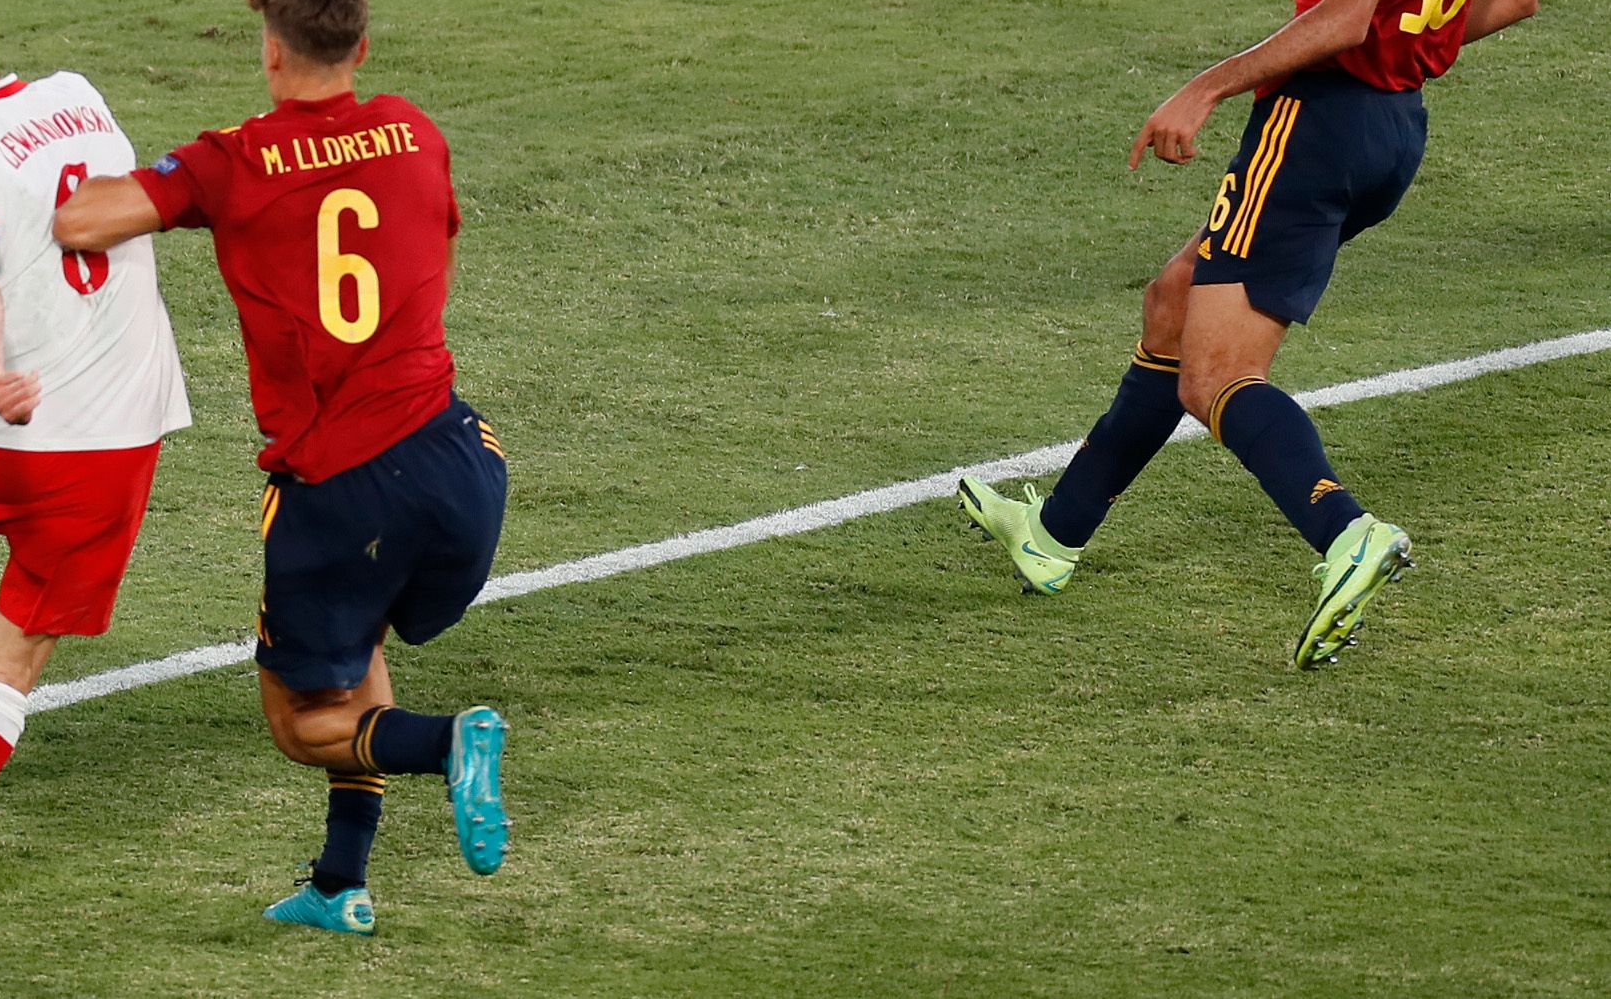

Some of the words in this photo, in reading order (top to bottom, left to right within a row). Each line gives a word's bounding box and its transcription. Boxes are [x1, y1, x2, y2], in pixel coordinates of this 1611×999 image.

[261, 144, 292, 175] M.
[293, 122, 420, 170] LLORENTE
[1209, 173, 1237, 232] 6
[317, 188, 380, 344] 6
